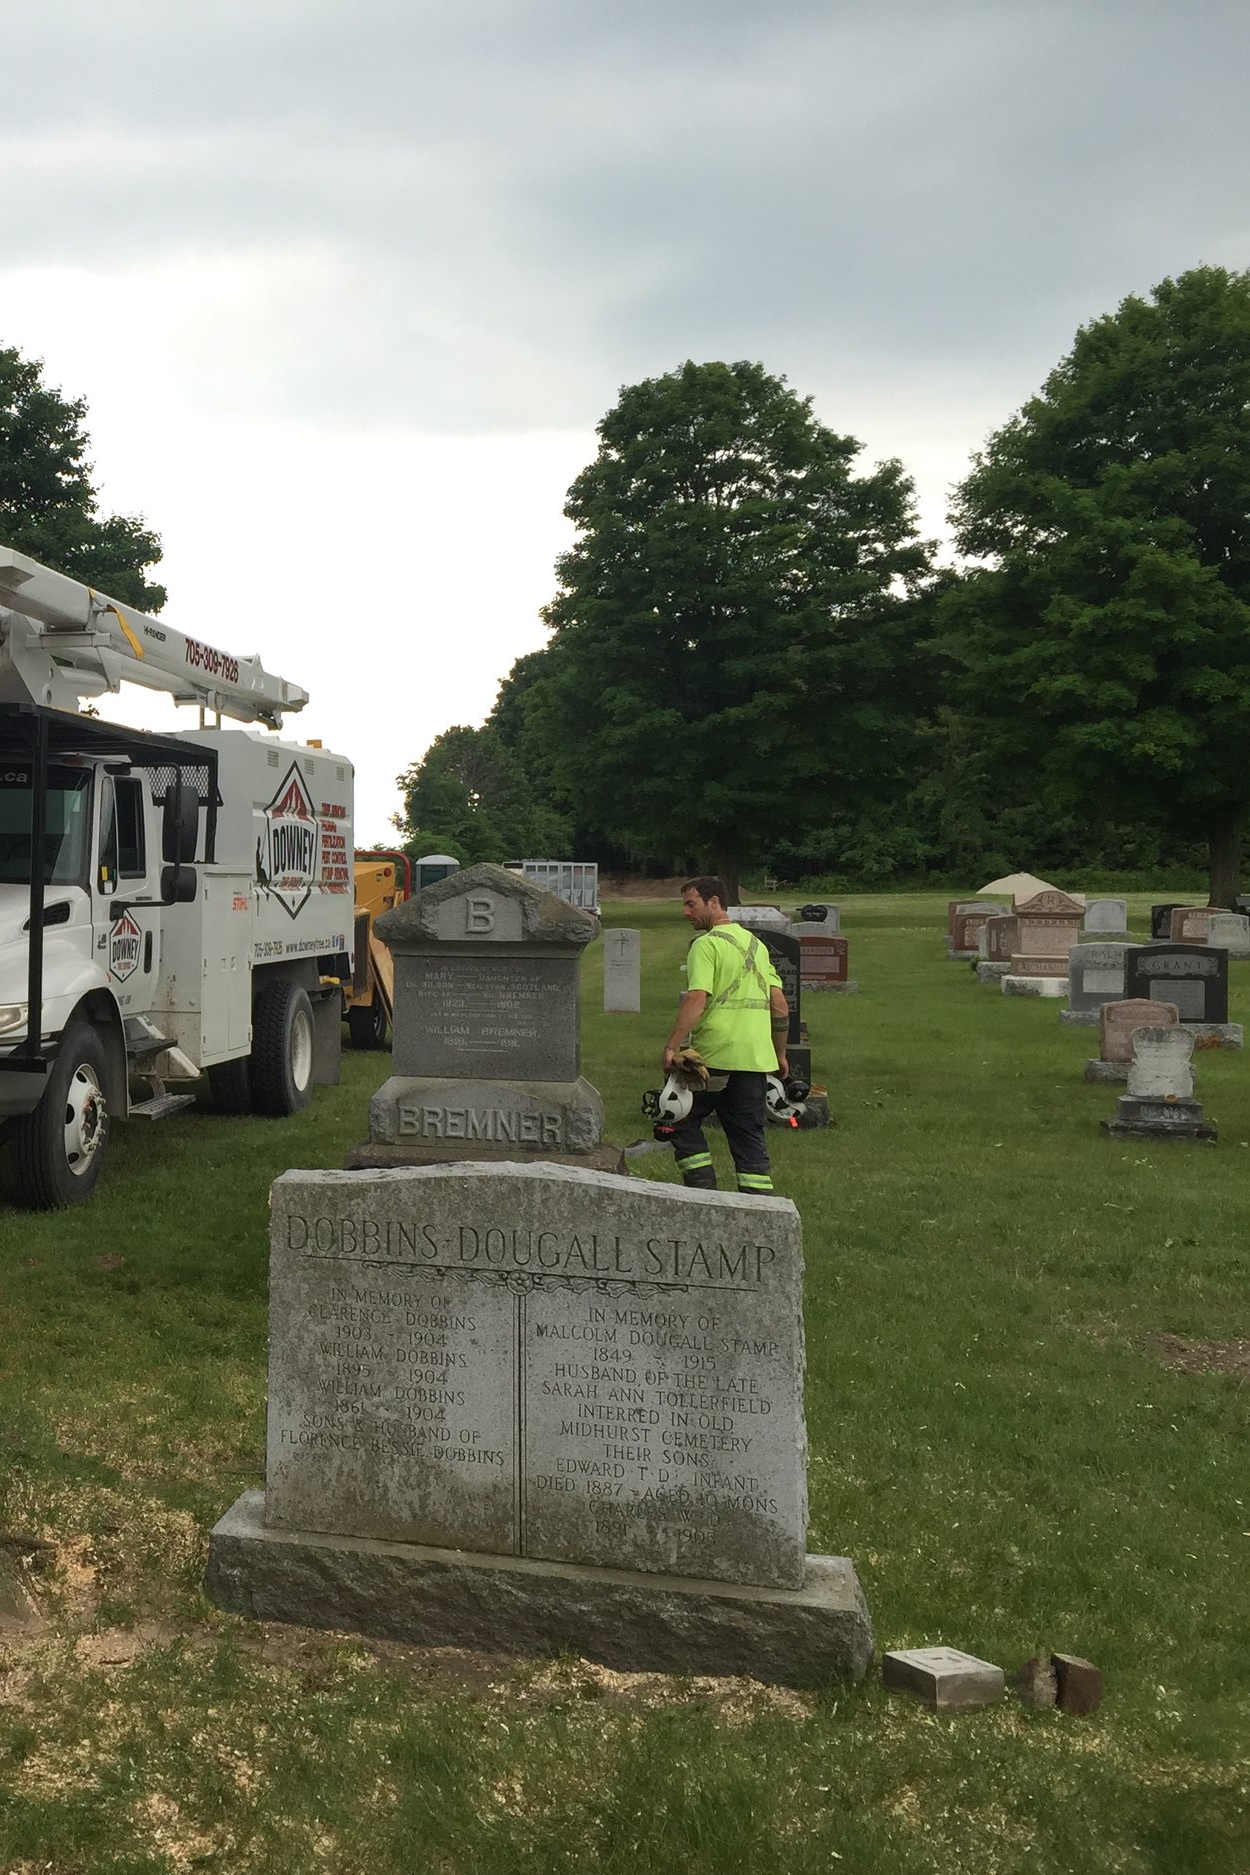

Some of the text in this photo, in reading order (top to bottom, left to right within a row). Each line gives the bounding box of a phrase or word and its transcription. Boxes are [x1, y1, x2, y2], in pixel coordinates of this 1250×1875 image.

[185, 637, 239, 683] 705-309-7926
[273, 825, 315, 876] DOWNEY
[465, 898, 496, 934] B
[112, 938, 139, 963] DOWNEY
[425, 972, 454, 980] MARY
[423, 1025, 470, 1035] WILLIAM
[397, 1103, 564, 1144] BREMNER
[644, 1238, 777, 1283] STAMP
[332, 1288, 451, 1309] IN MEMORY OF
[308, 1303, 476, 1331] CLARENCE DOBBINS
[589, 1308, 720, 1331] IN MEMORY OF
[337, 1326, 372, 1340] 1903
[409, 1332, 447, 1348] 1904
[536, 1322, 779, 1356] MALCOLM DOUGALL STAMP
[318, 1342, 467, 1368] WILLIAM DOBBINS
[593, 1348, 632, 1363] 1849
[684, 1355, 716, 1371] 1915
[337, 1362, 447, 1385] 1895 1904
[555, 1363, 759, 1394] HUSBAND OF THE LATE
[318, 1379, 465, 1405] WILLIAM DOBBINS
[542, 1380, 771, 1415] SARAH ANN TOLLERFIELD
[407, 1406, 446, 1422] 1904
[578, 1403, 734, 1432] INTERRED IN OLD
[303, 1413, 480, 1444] SONS & HUSBAND OF
[559, 1421, 753, 1453] MIDHURST CEMETERY
[280, 1429, 360, 1450] FLORENCE
[433, 1445, 504, 1465] DOBBINS
[603, 1443, 709, 1468] THEIR SONS
[556, 1457, 625, 1478] EDWARD
[694, 1472, 759, 1493] INFANT
[536, 1475, 575, 1492] DIED
[586, 1480, 623, 1497] 1887
[726, 1496, 778, 1514] MONS
[589, 1500, 666, 1521] CHARLES
